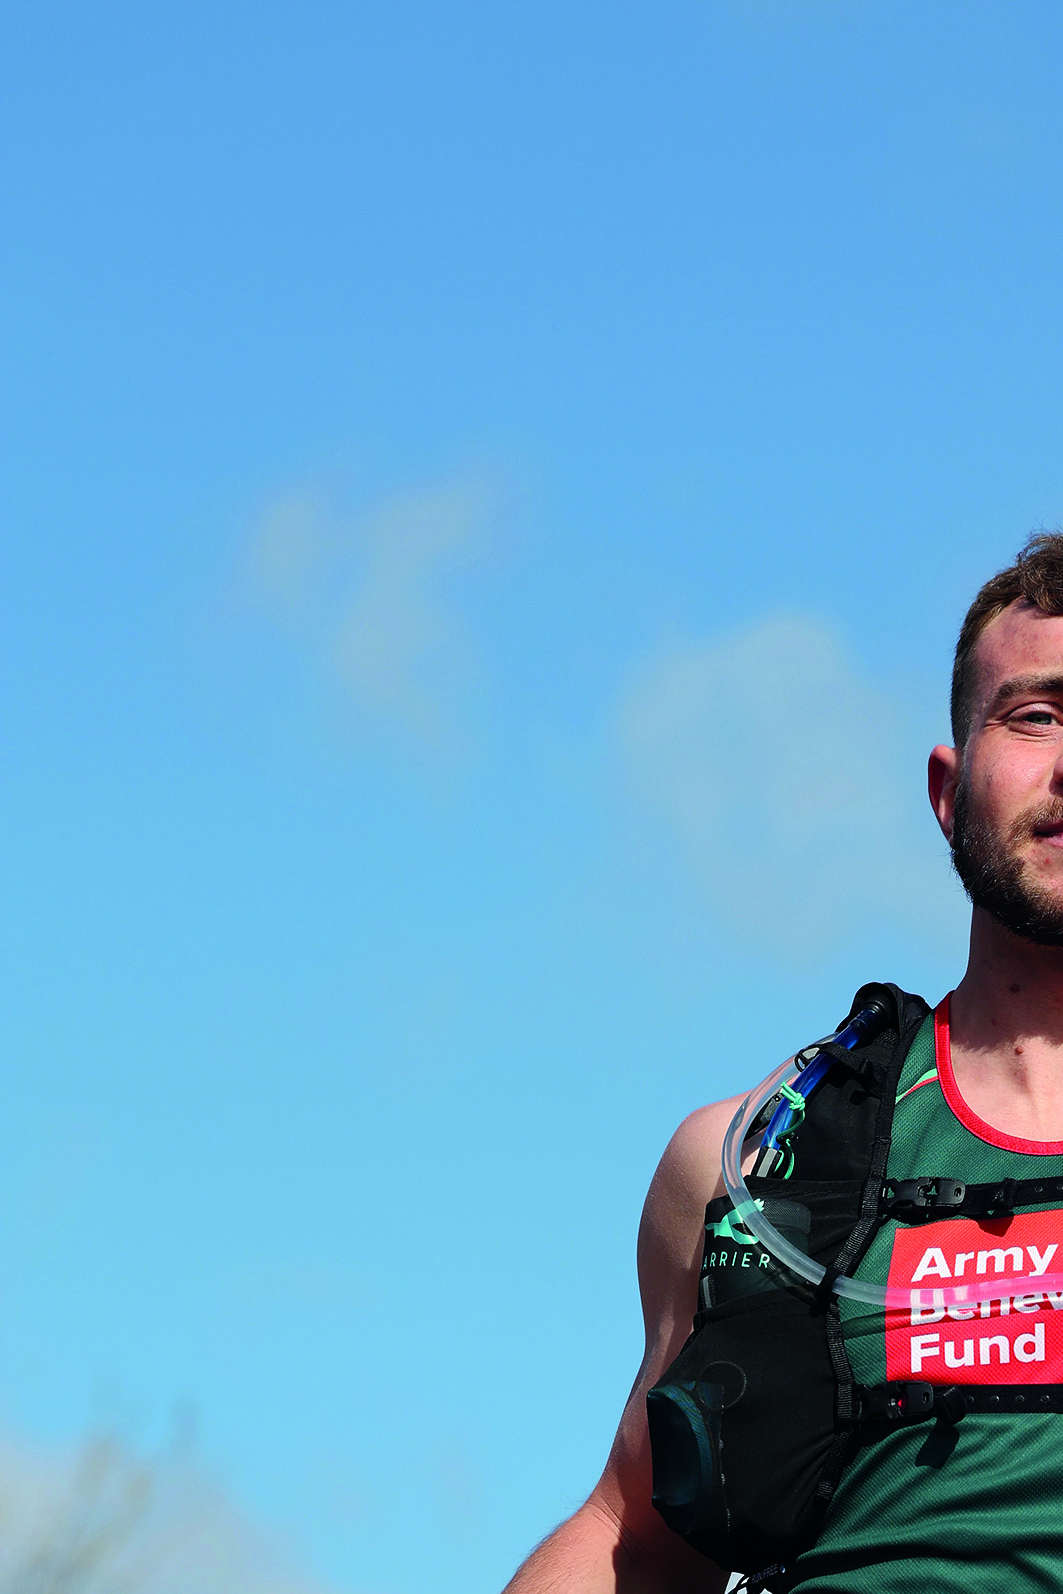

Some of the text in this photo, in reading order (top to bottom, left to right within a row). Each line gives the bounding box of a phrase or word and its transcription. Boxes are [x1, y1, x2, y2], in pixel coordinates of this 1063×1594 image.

[701, 1251, 771, 1271] ARRIER
[911, 1243, 1059, 1283] Army
[910, 1322, 1046, 1374] Fund
[762, 1563, 778, 1579] FREE
